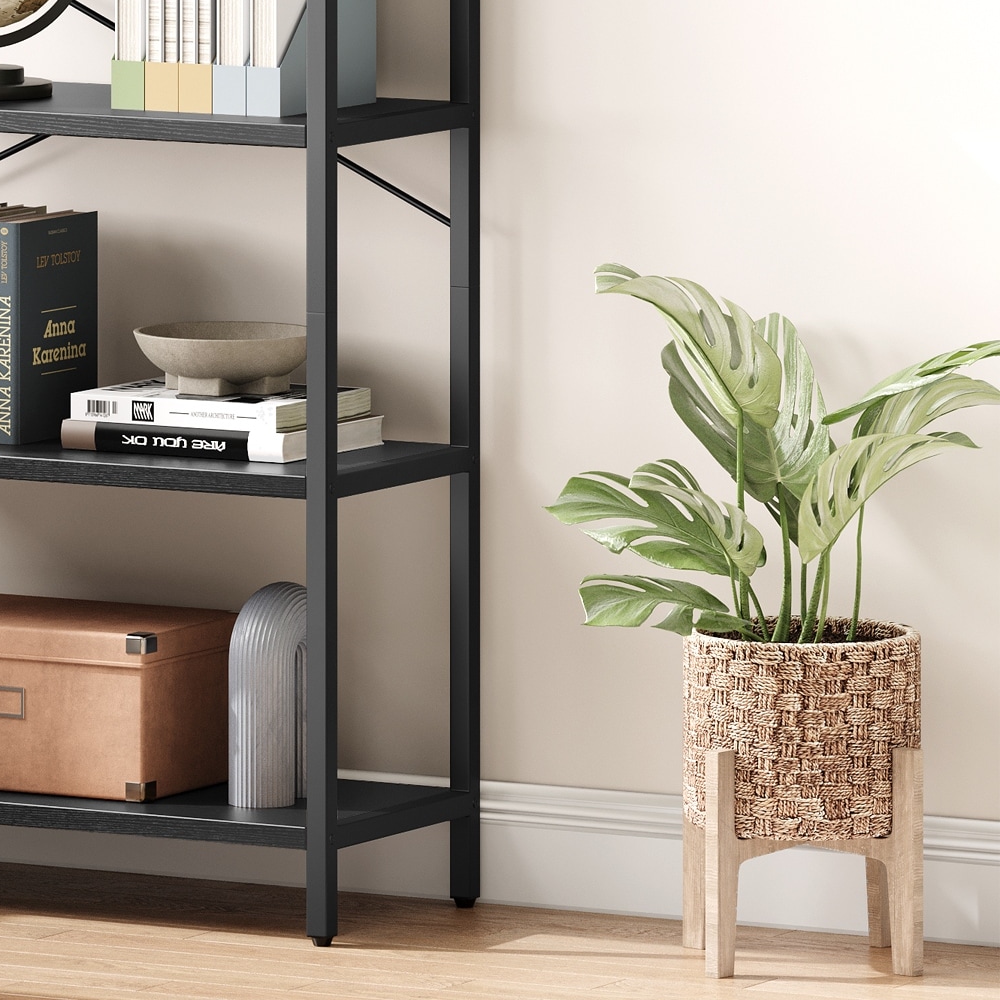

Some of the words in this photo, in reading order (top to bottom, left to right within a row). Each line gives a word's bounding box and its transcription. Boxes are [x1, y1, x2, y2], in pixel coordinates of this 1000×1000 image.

[36, 256, 48, 268] LEV
[50, 250, 81, 266] TOLSTOY
[44, 319, 76, 339] Anna
[32, 342, 86, 366] Karenina
[133, 402, 153, 420] MARK
[122, 434, 147, 446] OK
[192, 440, 225, 452] ARE
